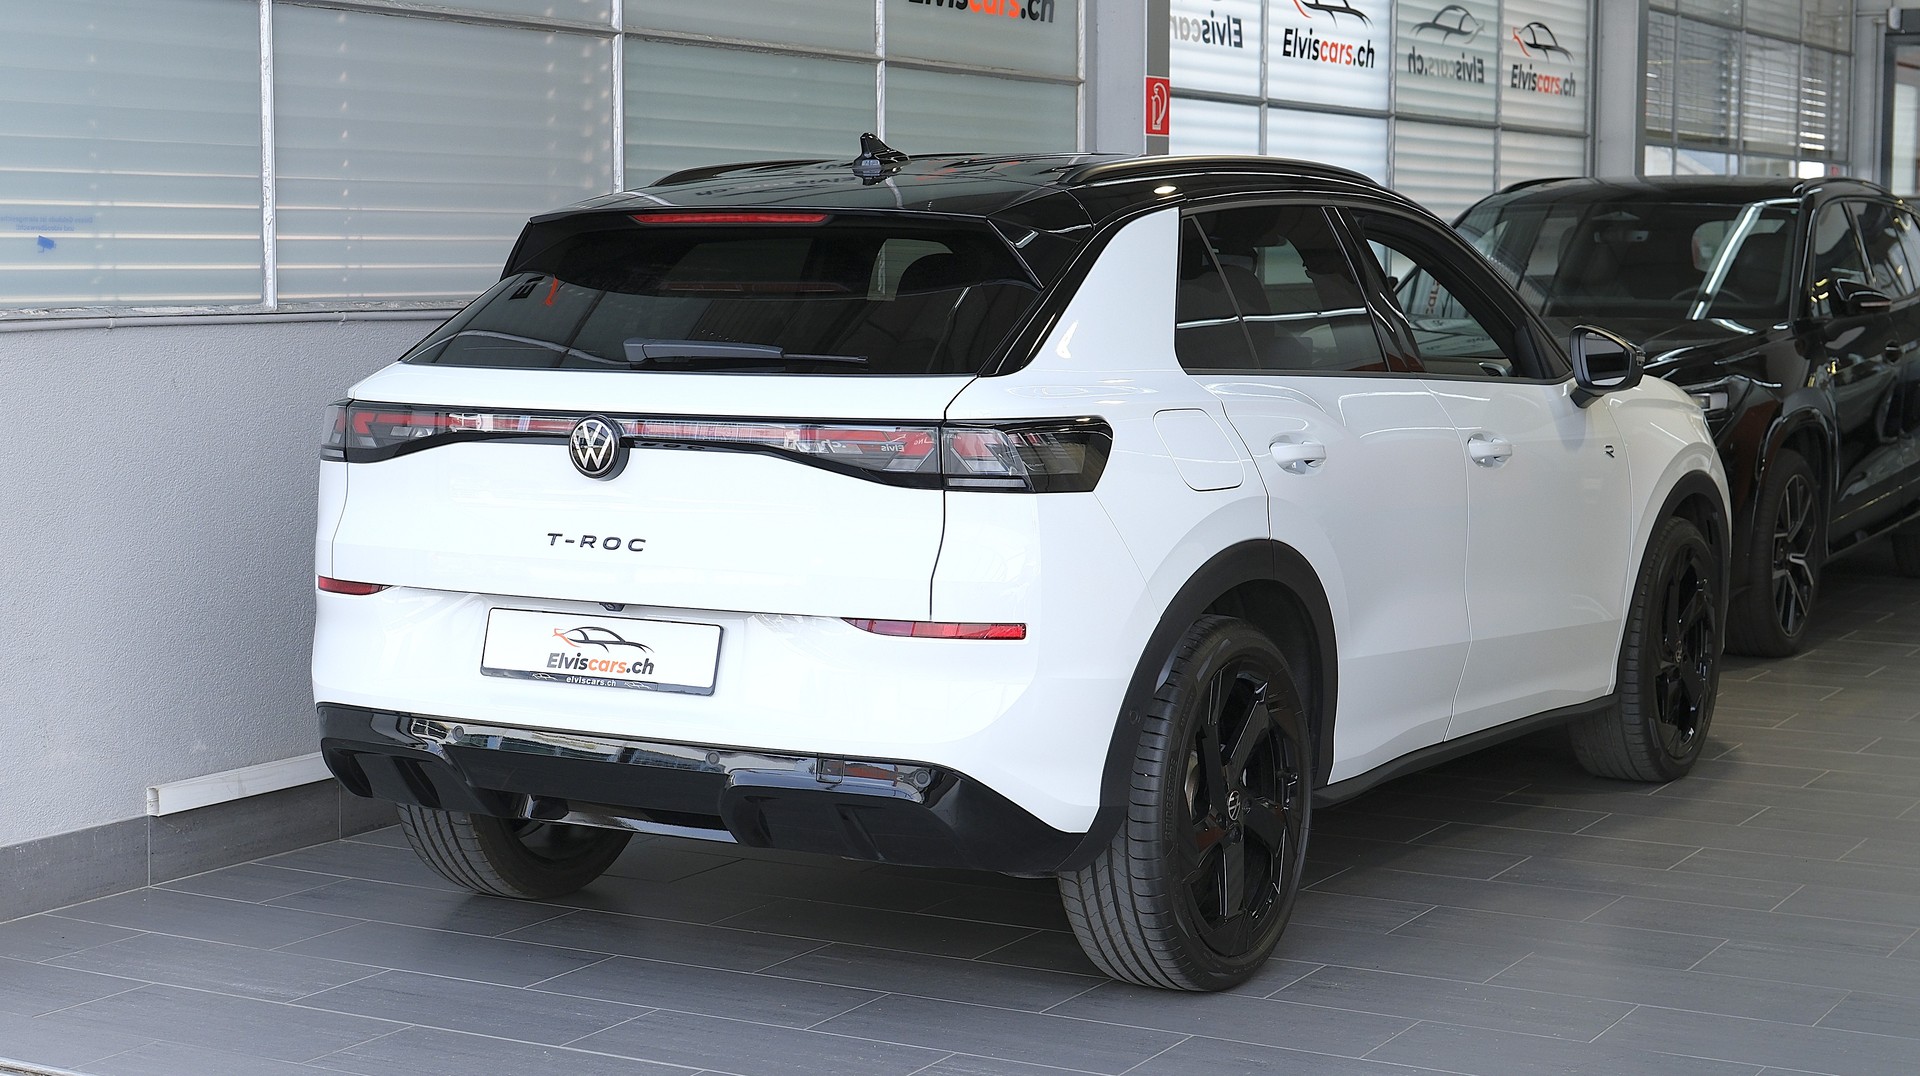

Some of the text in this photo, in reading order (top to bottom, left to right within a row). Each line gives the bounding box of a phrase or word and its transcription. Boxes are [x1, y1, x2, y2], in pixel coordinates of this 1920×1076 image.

[1282, 28, 1375, 69] Elviscars.ch
[1511, 62, 1576, 97] Elviscars.ch
[547, 533, 646, 552] T-ROC
[547, 651, 655, 675] Elviscars.ch
[566, 676, 617, 687] elviscars.ch
